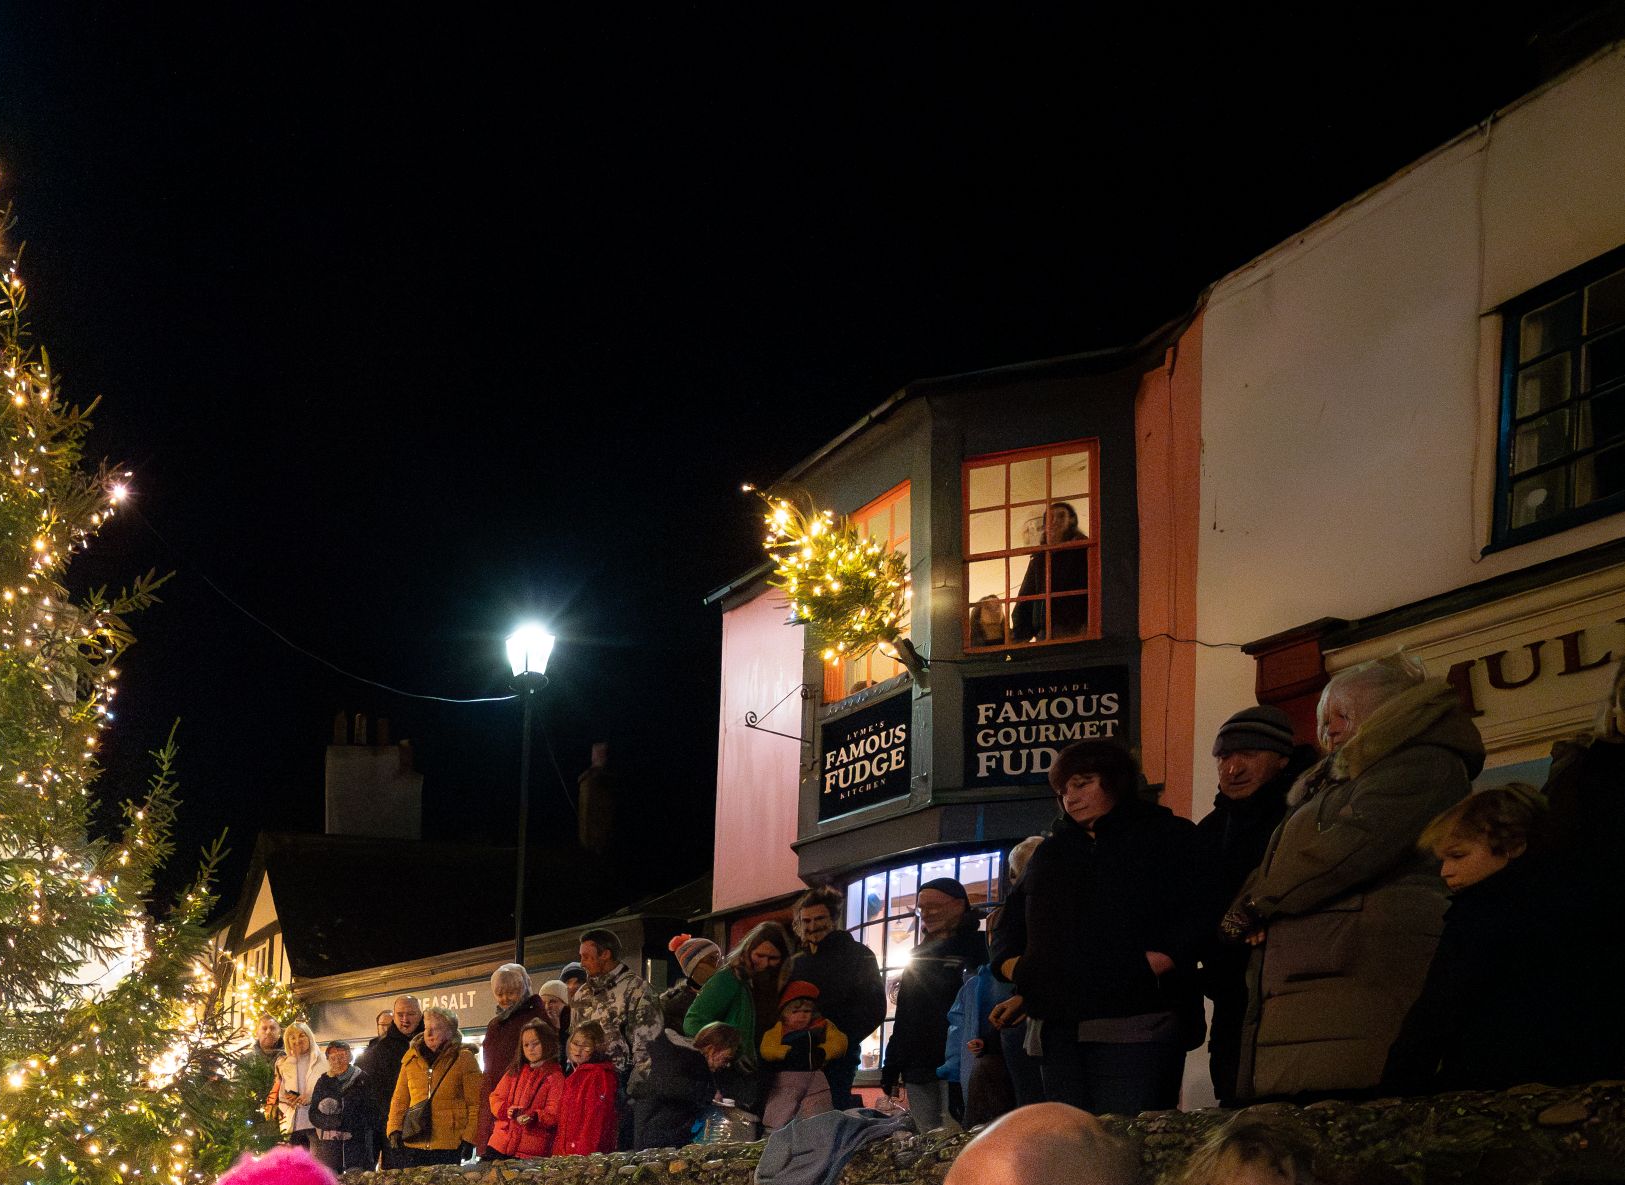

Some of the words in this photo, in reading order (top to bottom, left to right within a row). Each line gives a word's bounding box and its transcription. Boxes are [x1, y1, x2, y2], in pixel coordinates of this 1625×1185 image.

[1005, 682, 1090, 697] HANDMADE
[976, 692, 1120, 725] FAMOUS
[846, 720, 885, 741] LYME'S
[976, 719, 1119, 747] GOURMET
[825, 723, 907, 770] FAMOUS
[823, 745, 906, 794] FUDGE
[976, 747, 1060, 778] FUD
[839, 778, 887, 800] KITCHEN
[418, 990, 476, 1012] EASALT
